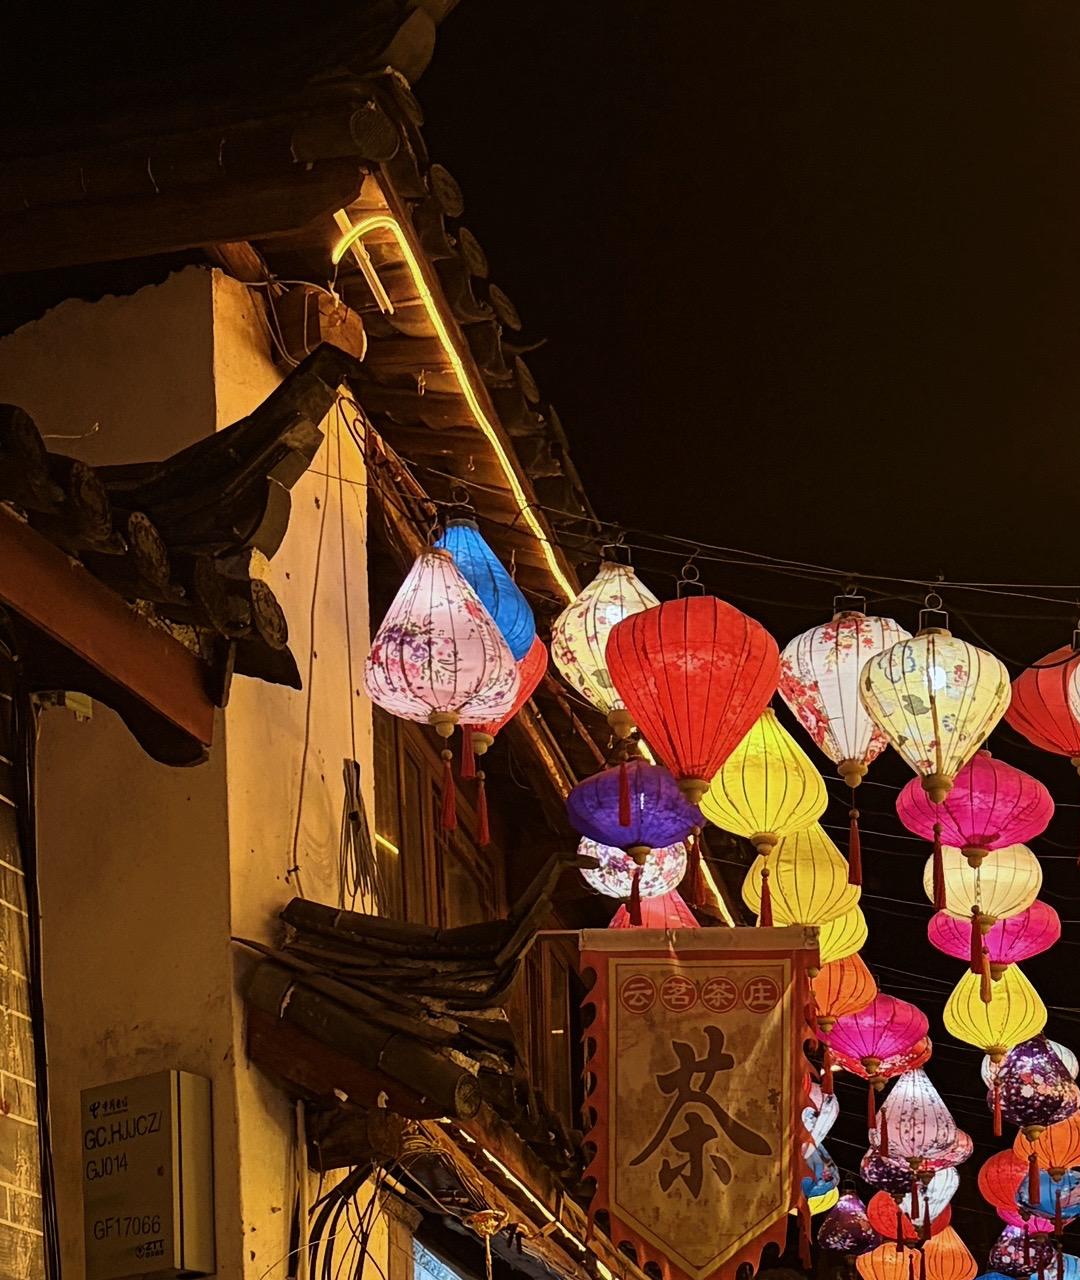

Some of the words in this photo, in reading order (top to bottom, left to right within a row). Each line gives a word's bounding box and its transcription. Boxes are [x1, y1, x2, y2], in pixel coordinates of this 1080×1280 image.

[621, 980, 778, 1010] 云茗茶庄
[629, 1025, 773, 1200] 茶
[86, 1153, 129, 1181] GJ014
[94, 1215, 161, 1241] GF17066
